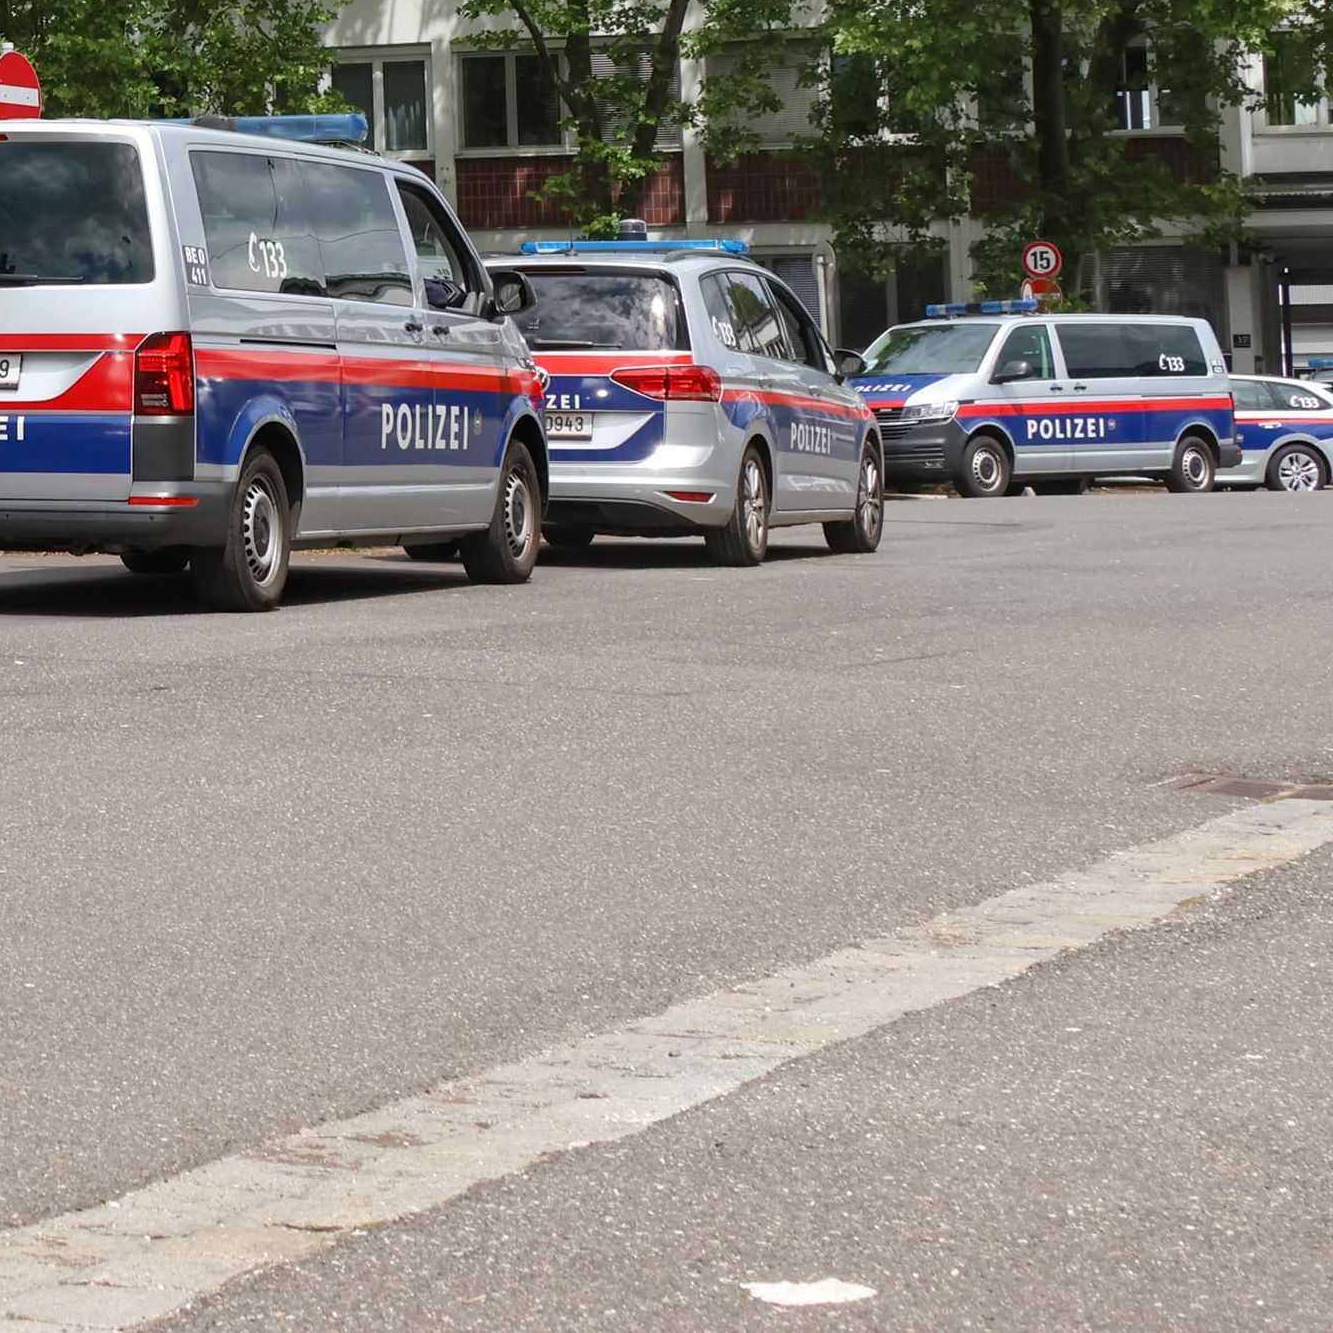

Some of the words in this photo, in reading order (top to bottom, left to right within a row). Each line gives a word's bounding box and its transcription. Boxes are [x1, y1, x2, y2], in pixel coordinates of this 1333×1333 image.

[185, 247, 198, 263] BE
[259, 242, 287, 278] 133
[1031, 251, 1051, 270] 15
[192, 267, 206, 284] 411
[718, 322, 736, 347] 133
[1167, 356, 1185, 372] 133
[546, 394, 580, 409] ZEI
[1300, 396, 1320, 409] 133
[381, 403, 469, 450] POLIZEI
[1026, 418, 1105, 439] POLIZEI
[790, 422, 831, 454] POLIZEI
